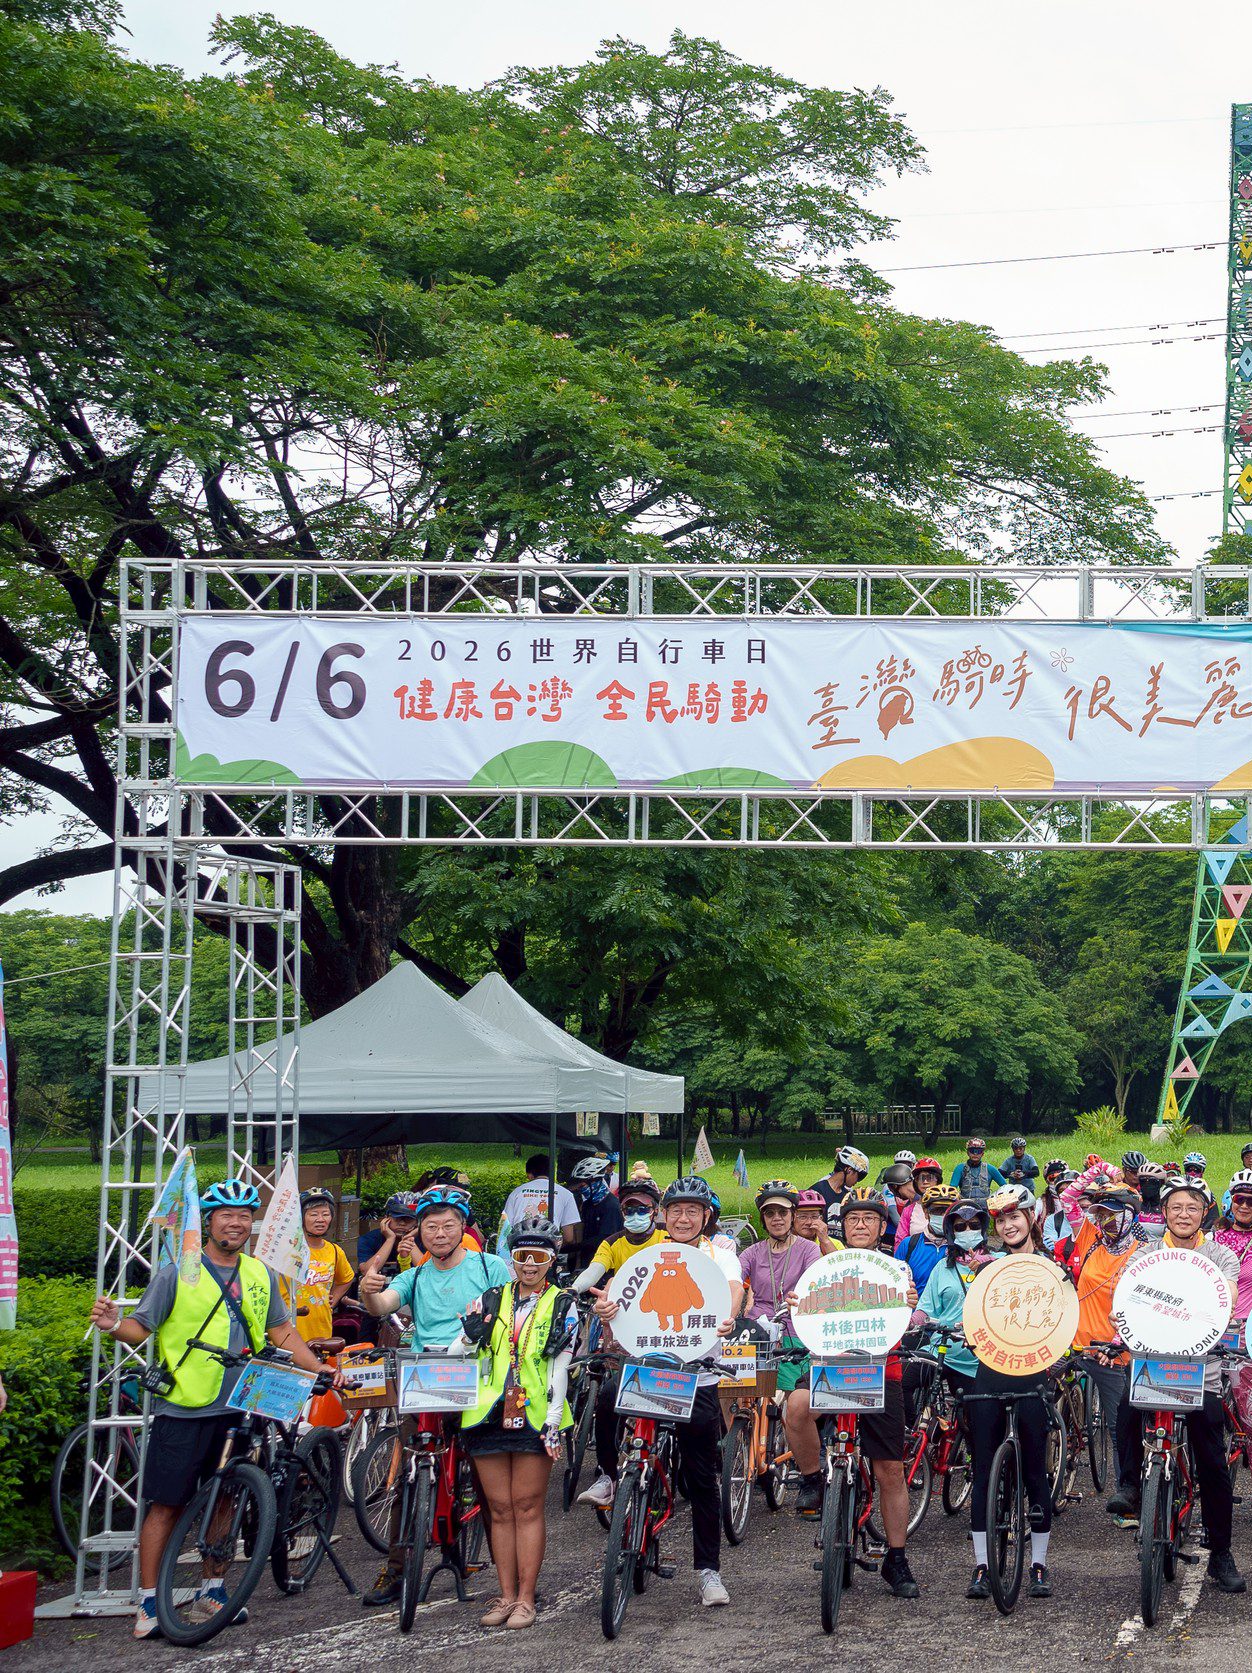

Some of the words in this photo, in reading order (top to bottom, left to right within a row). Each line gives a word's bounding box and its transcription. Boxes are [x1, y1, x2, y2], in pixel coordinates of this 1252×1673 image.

[397, 637, 769, 665] 2026世界自行車日
[203, 640, 366, 722] 6/6
[392, 675, 574, 724] 健康台灣
[595, 679, 770, 724] 全民騎動
[617, 1266, 649, 1312] 2026
[1130, 1251, 1187, 1278] PINGTUNG
[1191, 1256, 1215, 1277] BIKE
[1213, 1277, 1228, 1309] TOUR
[1133, 1284, 1185, 1307] 屏東縣政府
[687, 1314, 717, 1328] 屏東
[822, 1317, 886, 1337] 林後四林
[1116, 1310, 1134, 1342] TOUR
[636, 1335, 703, 1348] 單車旅遊季
[736, 1347, 743, 1356] 2
[822, 1336, 888, 1351] 平地森林園區
[972, 1327, 1053, 1369] 世界自行車日
